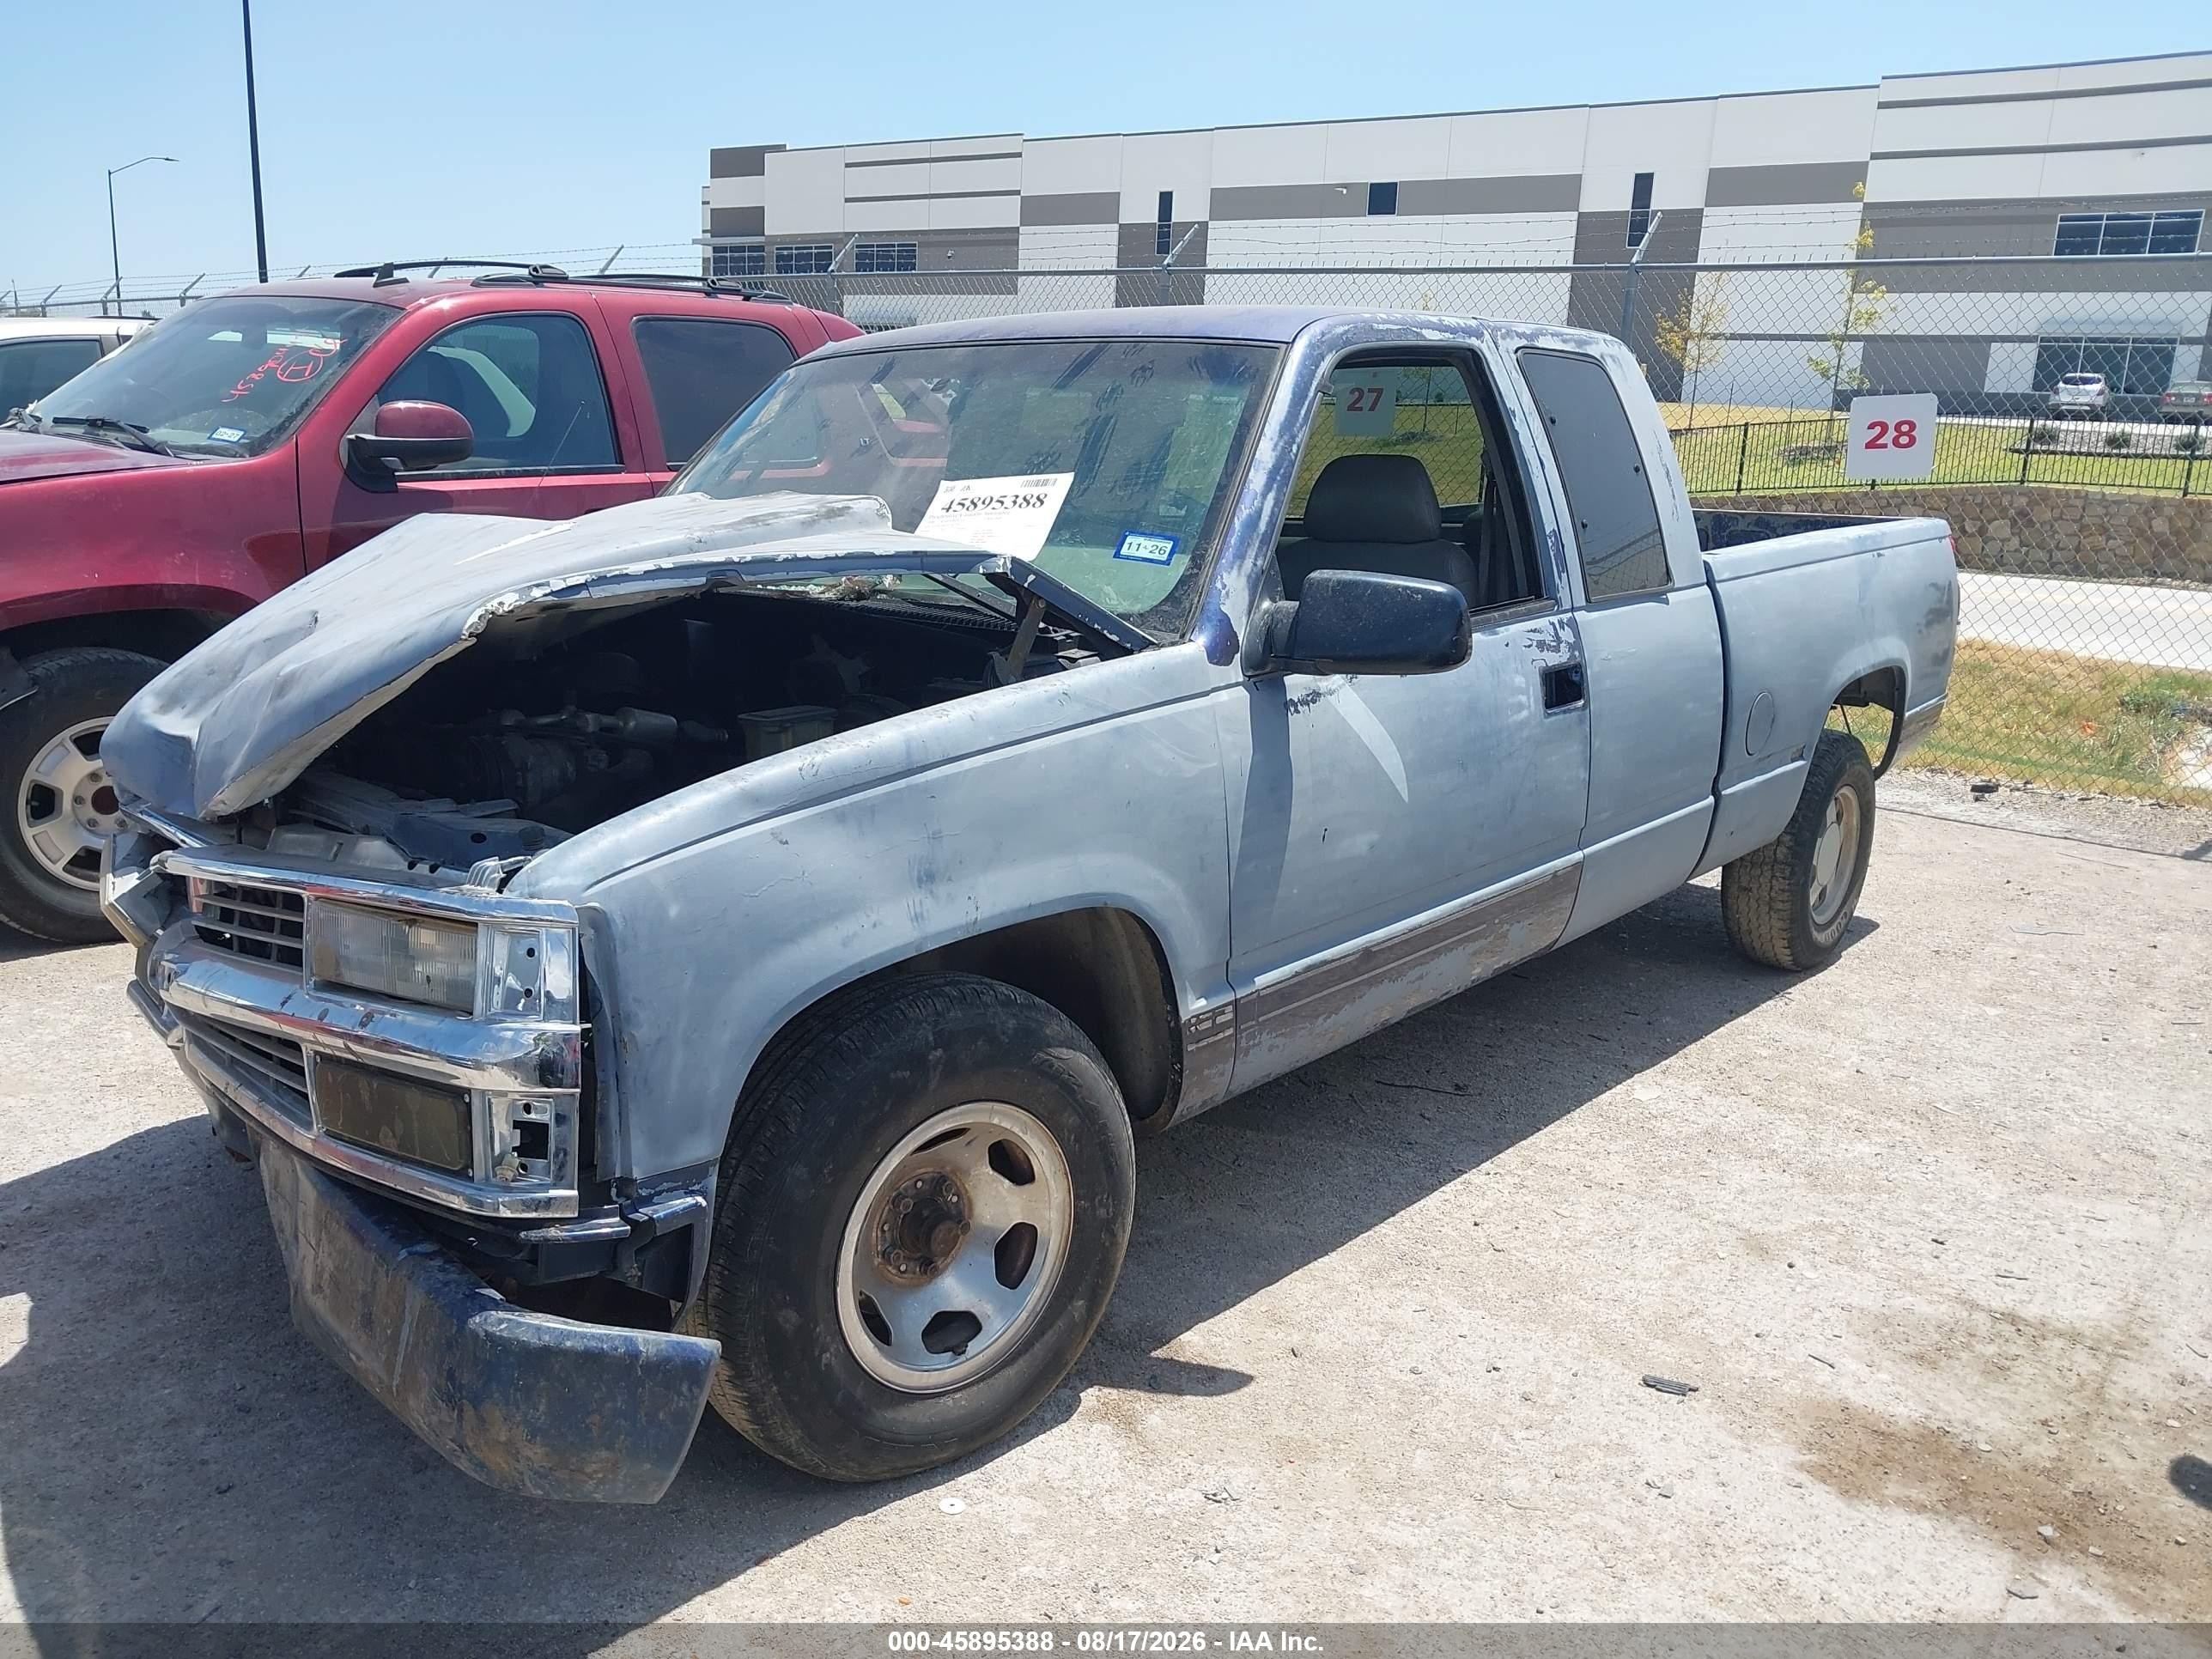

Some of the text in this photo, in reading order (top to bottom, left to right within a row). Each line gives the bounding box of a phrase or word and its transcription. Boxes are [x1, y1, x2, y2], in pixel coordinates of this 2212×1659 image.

[1346, 387, 1383, 411] 27
[1865, 419, 1917, 449] 28
[941, 493, 1048, 514] 45895388
